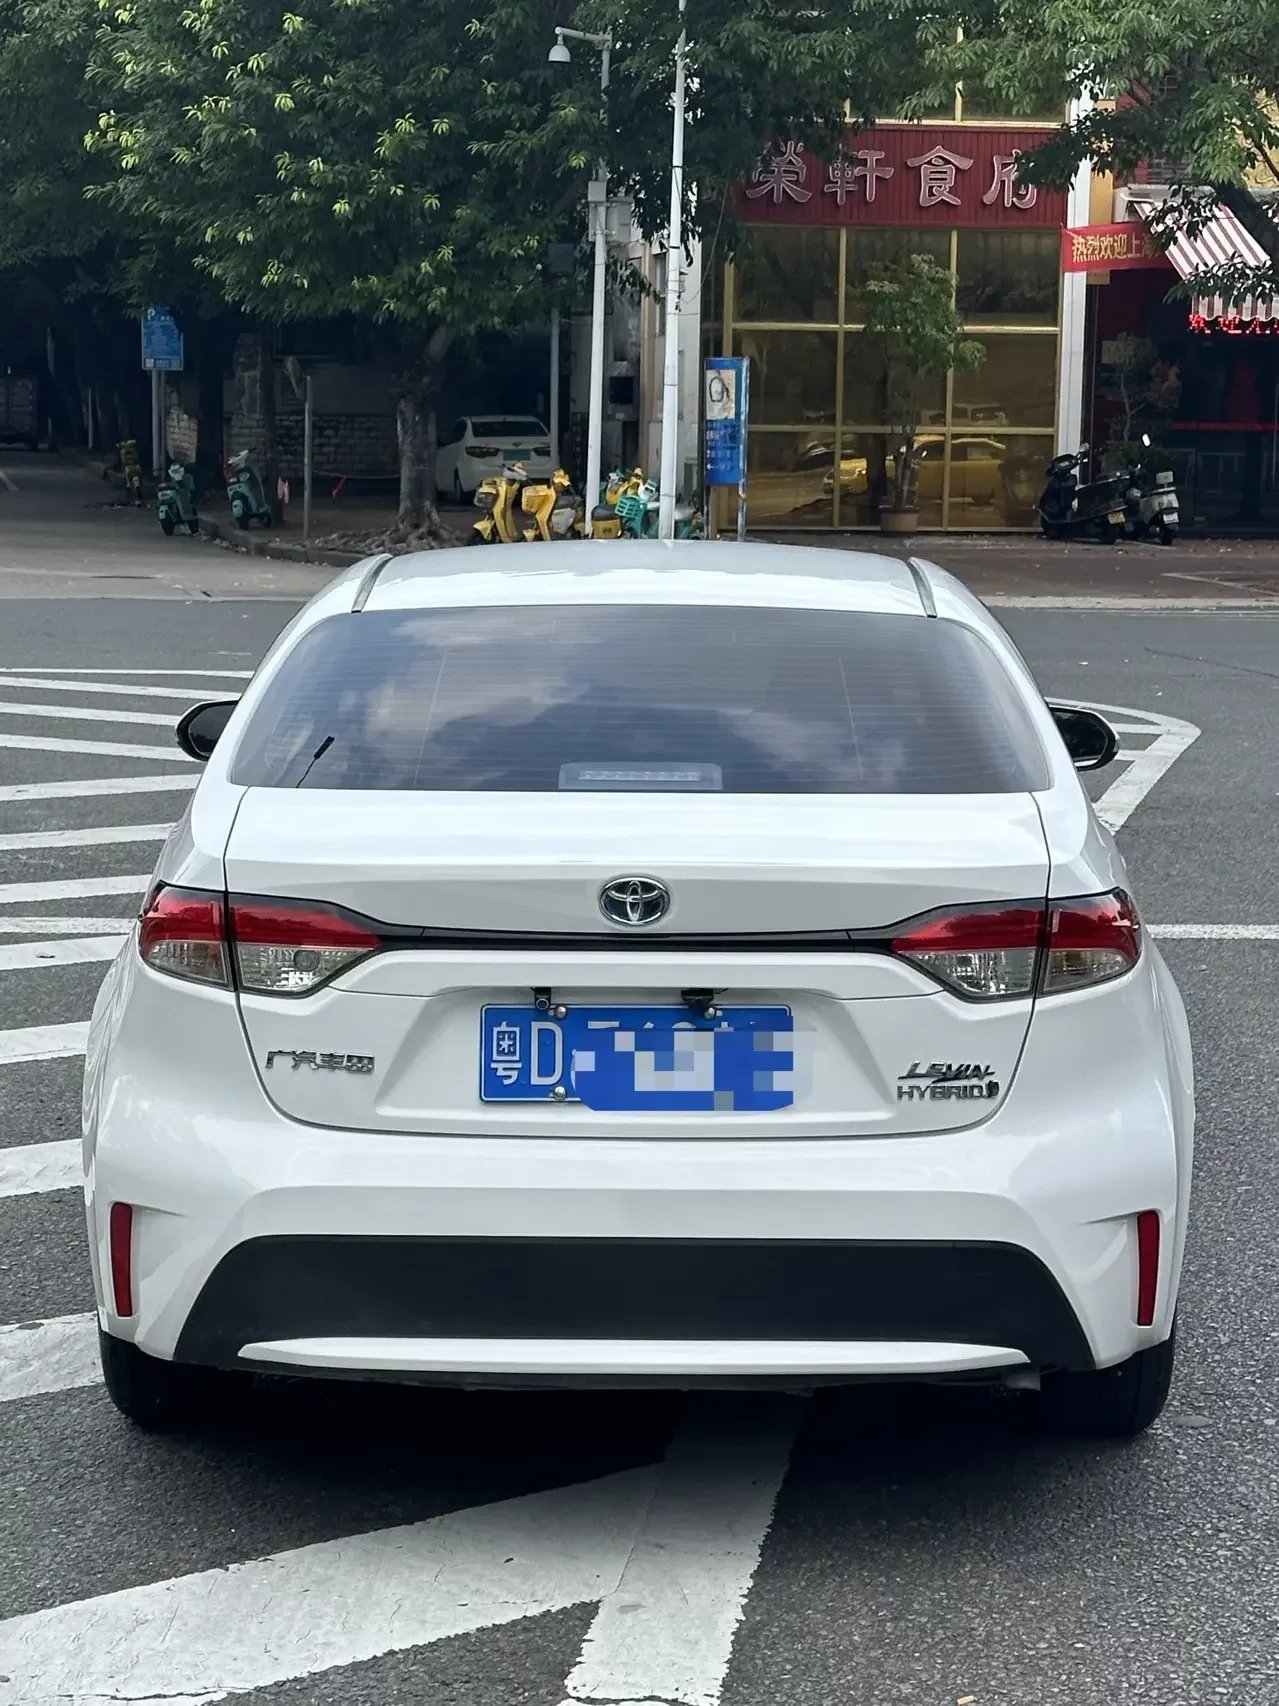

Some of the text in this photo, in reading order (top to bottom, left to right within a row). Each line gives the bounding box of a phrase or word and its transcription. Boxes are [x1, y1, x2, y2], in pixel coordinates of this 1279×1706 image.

[1072, 233, 1164, 262] 热烈欢迎上海
[897, 1061, 996, 1084] LEVIN
[897, 1084, 984, 1101] HYBRID
